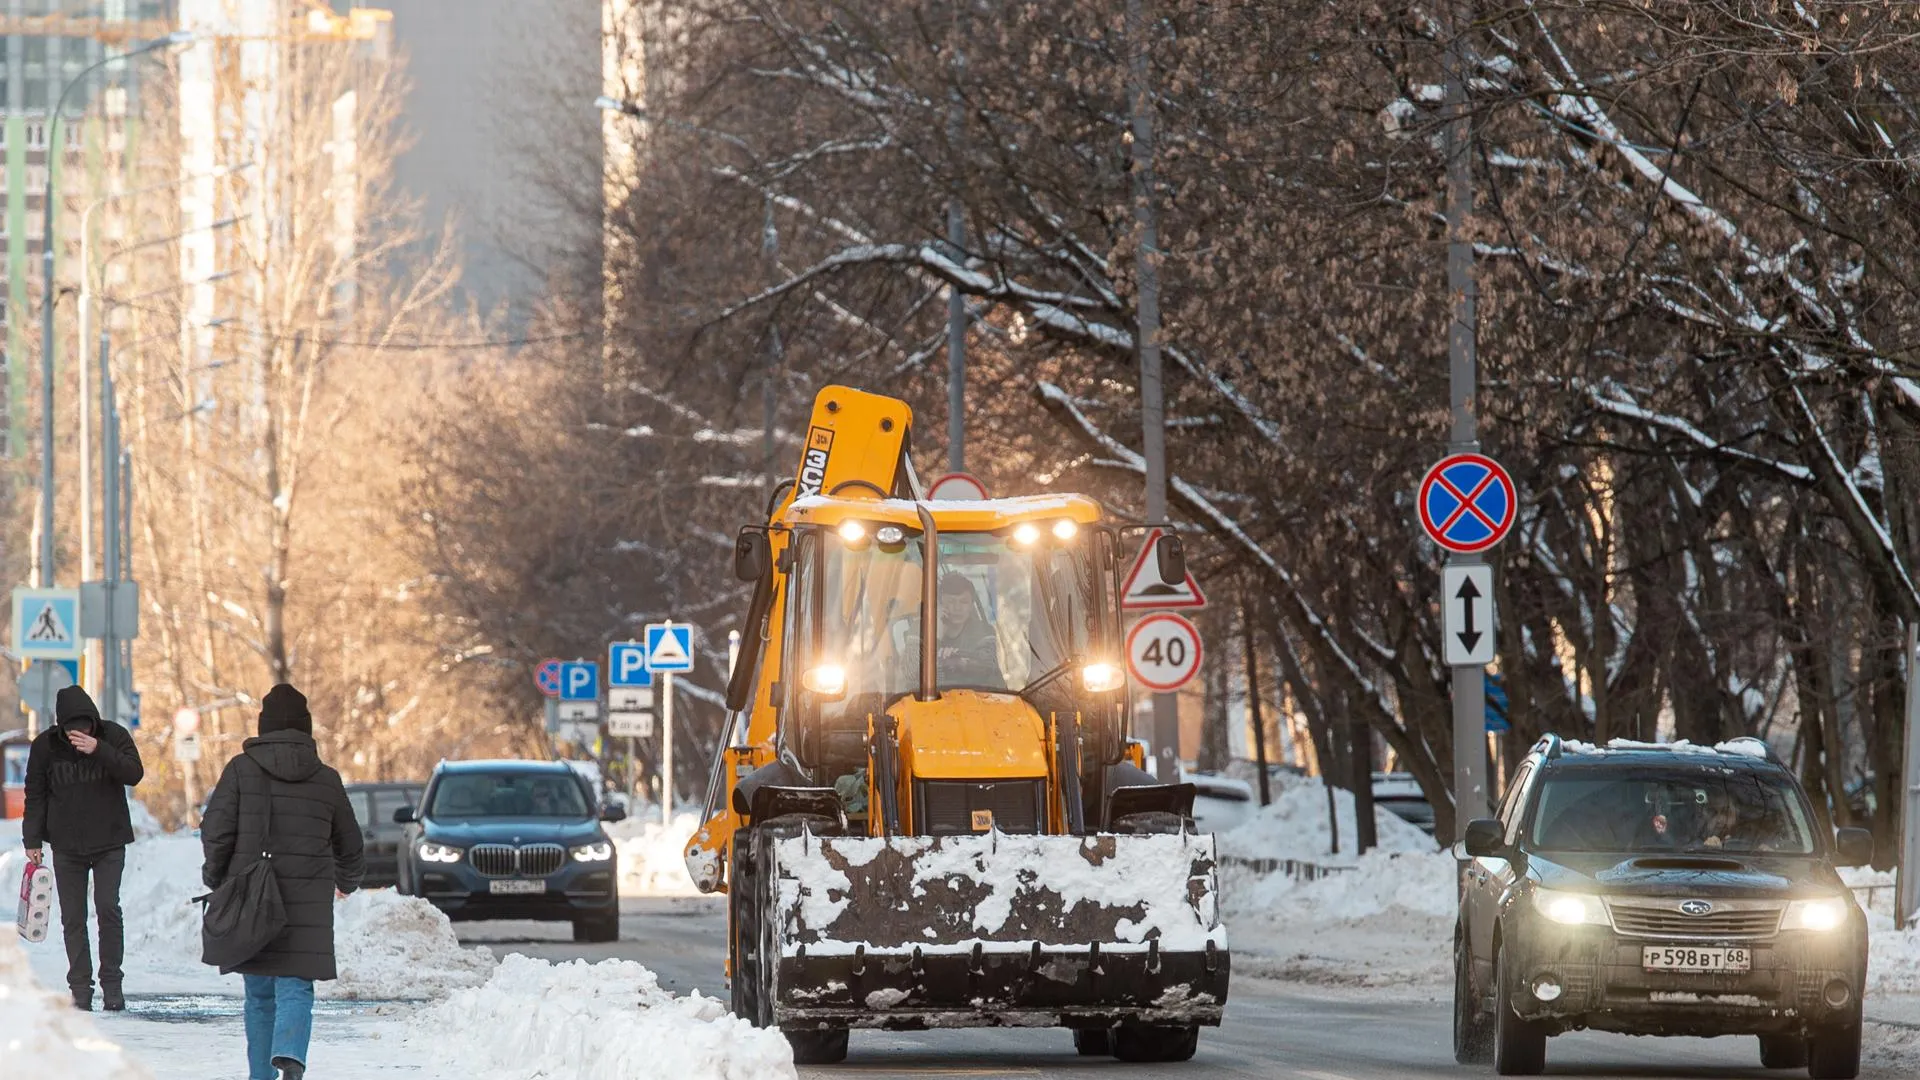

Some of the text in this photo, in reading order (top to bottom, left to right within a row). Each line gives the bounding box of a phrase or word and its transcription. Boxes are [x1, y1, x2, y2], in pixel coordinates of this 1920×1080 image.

[797, 449, 827, 500] 3CX
[620, 648, 644, 682] P
[1141, 637, 1185, 667] 40
[569, 666, 591, 696] P
